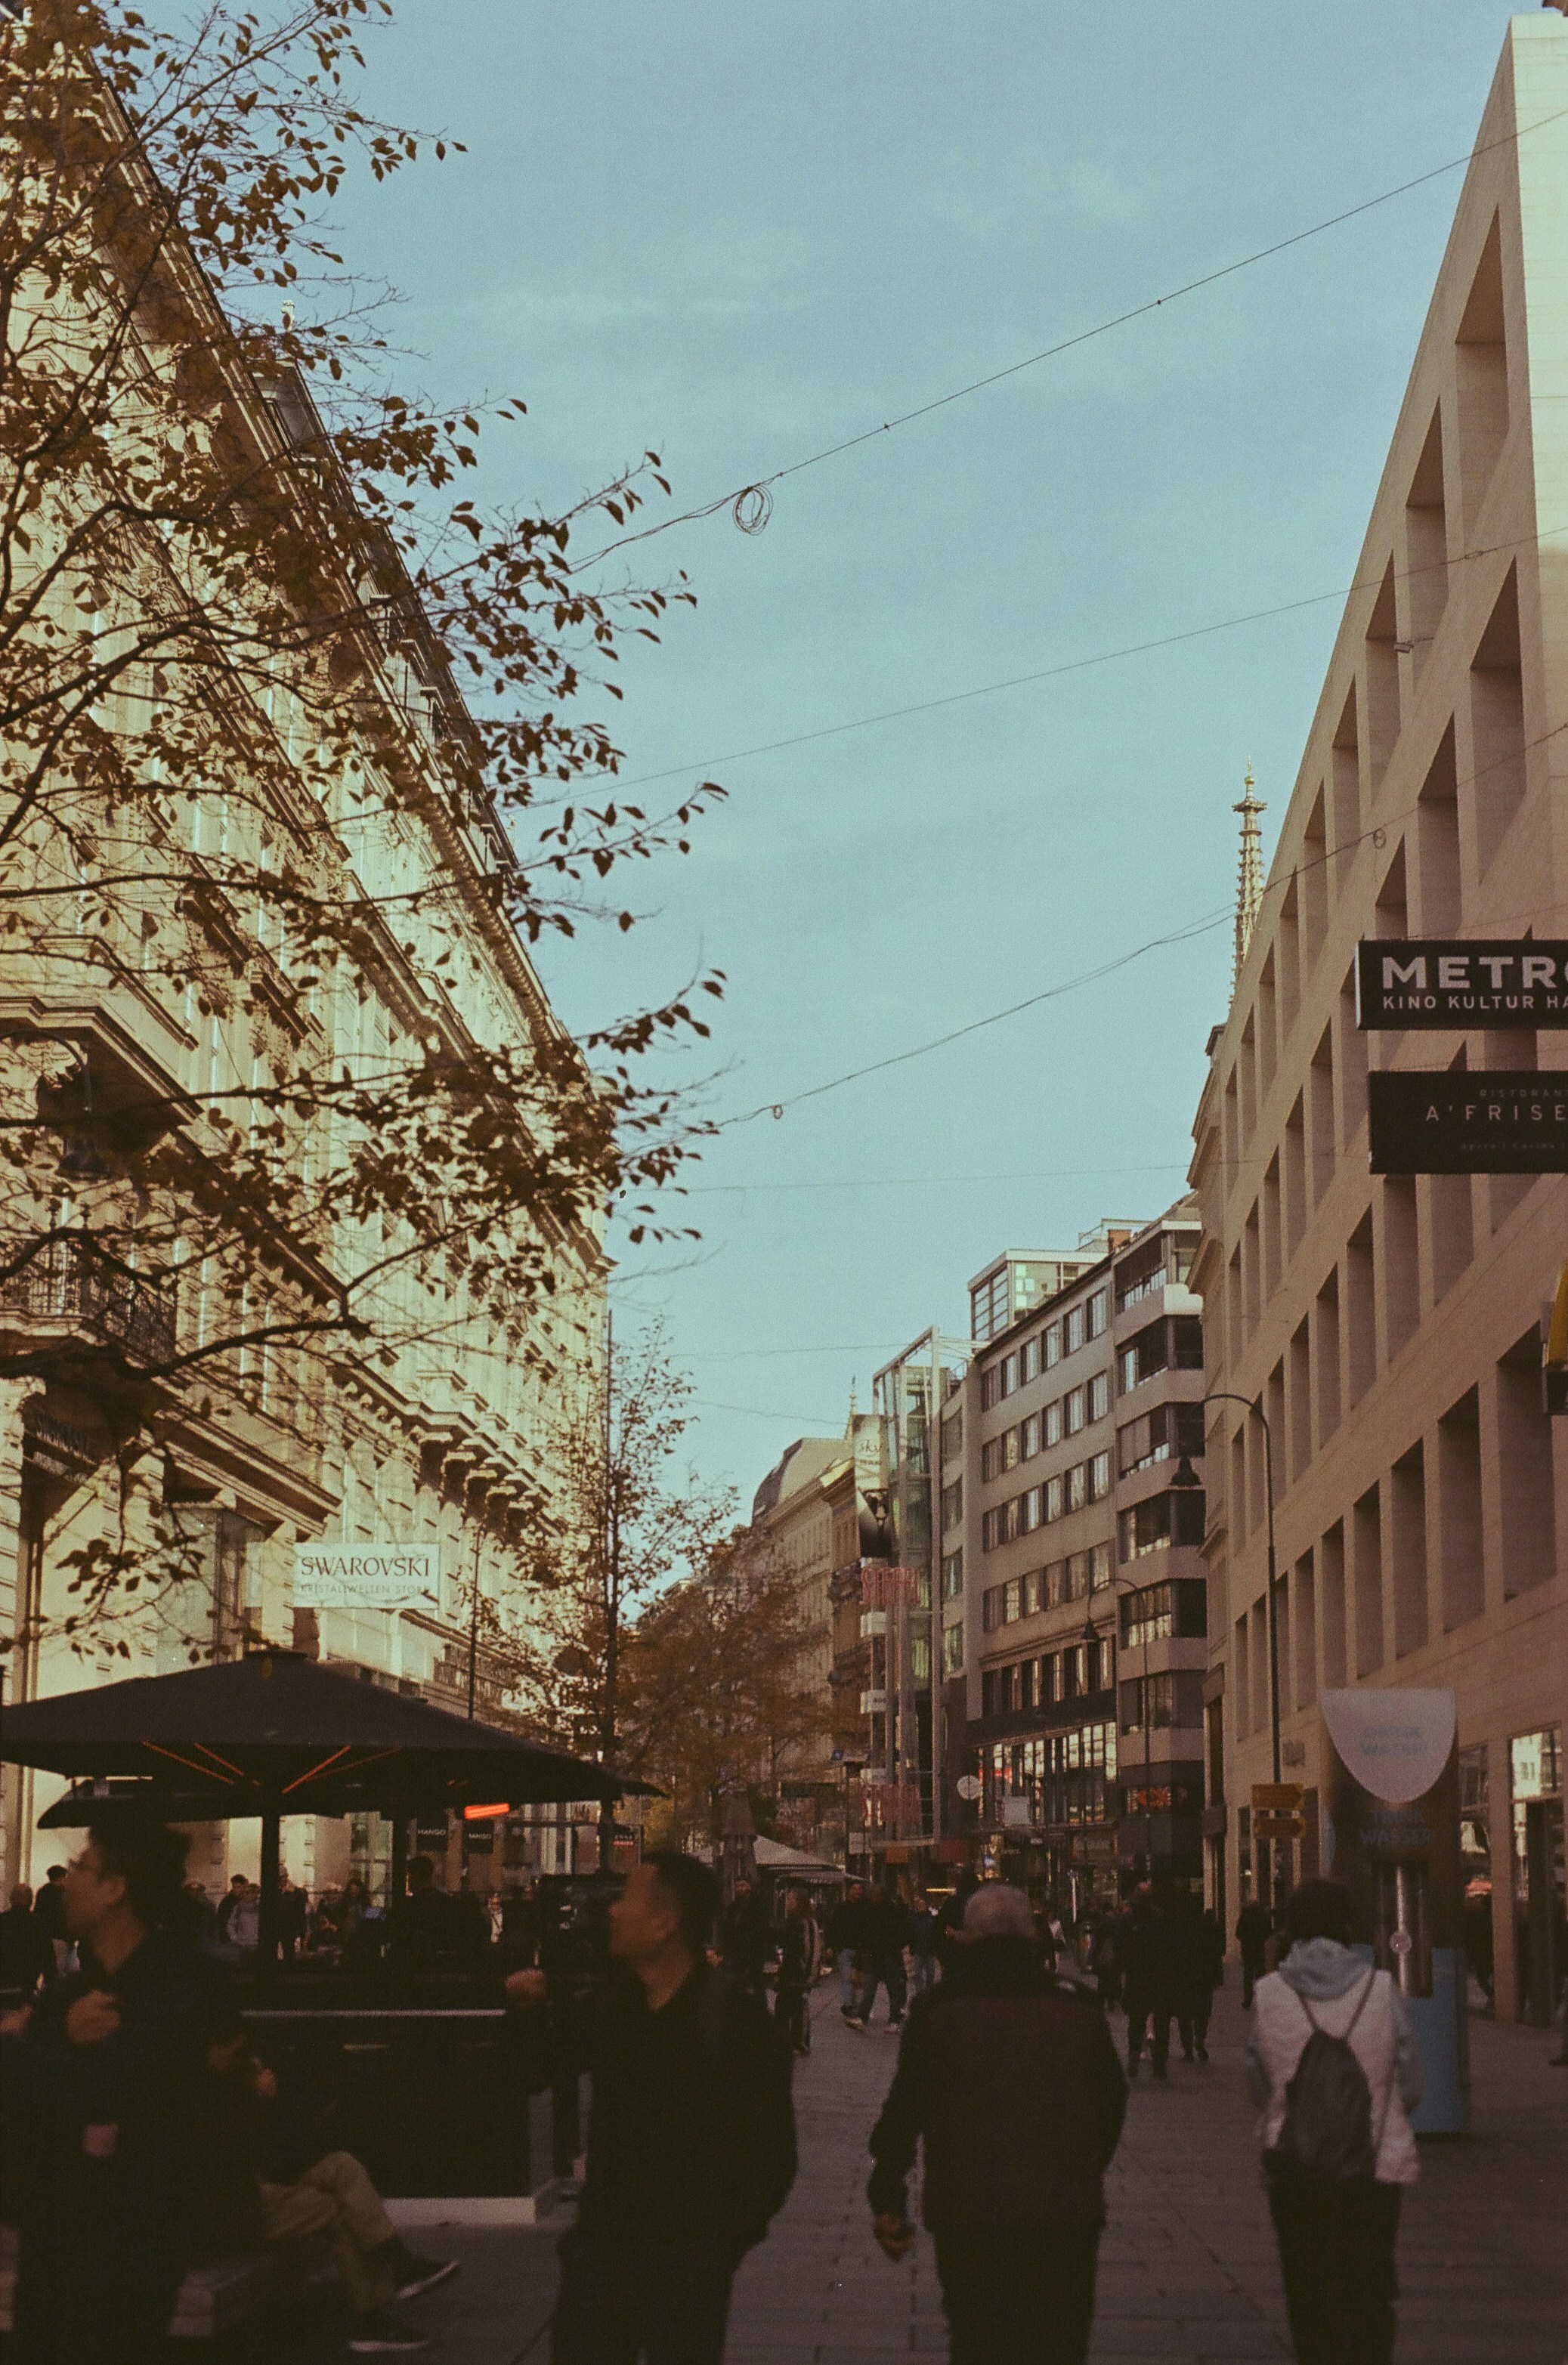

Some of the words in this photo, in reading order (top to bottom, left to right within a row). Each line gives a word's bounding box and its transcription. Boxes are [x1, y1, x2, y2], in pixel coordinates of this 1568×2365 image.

[1382, 956, 1568, 989] METR
[1383, 995, 1437, 1009] KINO
[1448, 995, 1535, 1009] KULTUR
[301, 1556, 429, 1577] SWAROVSKI
